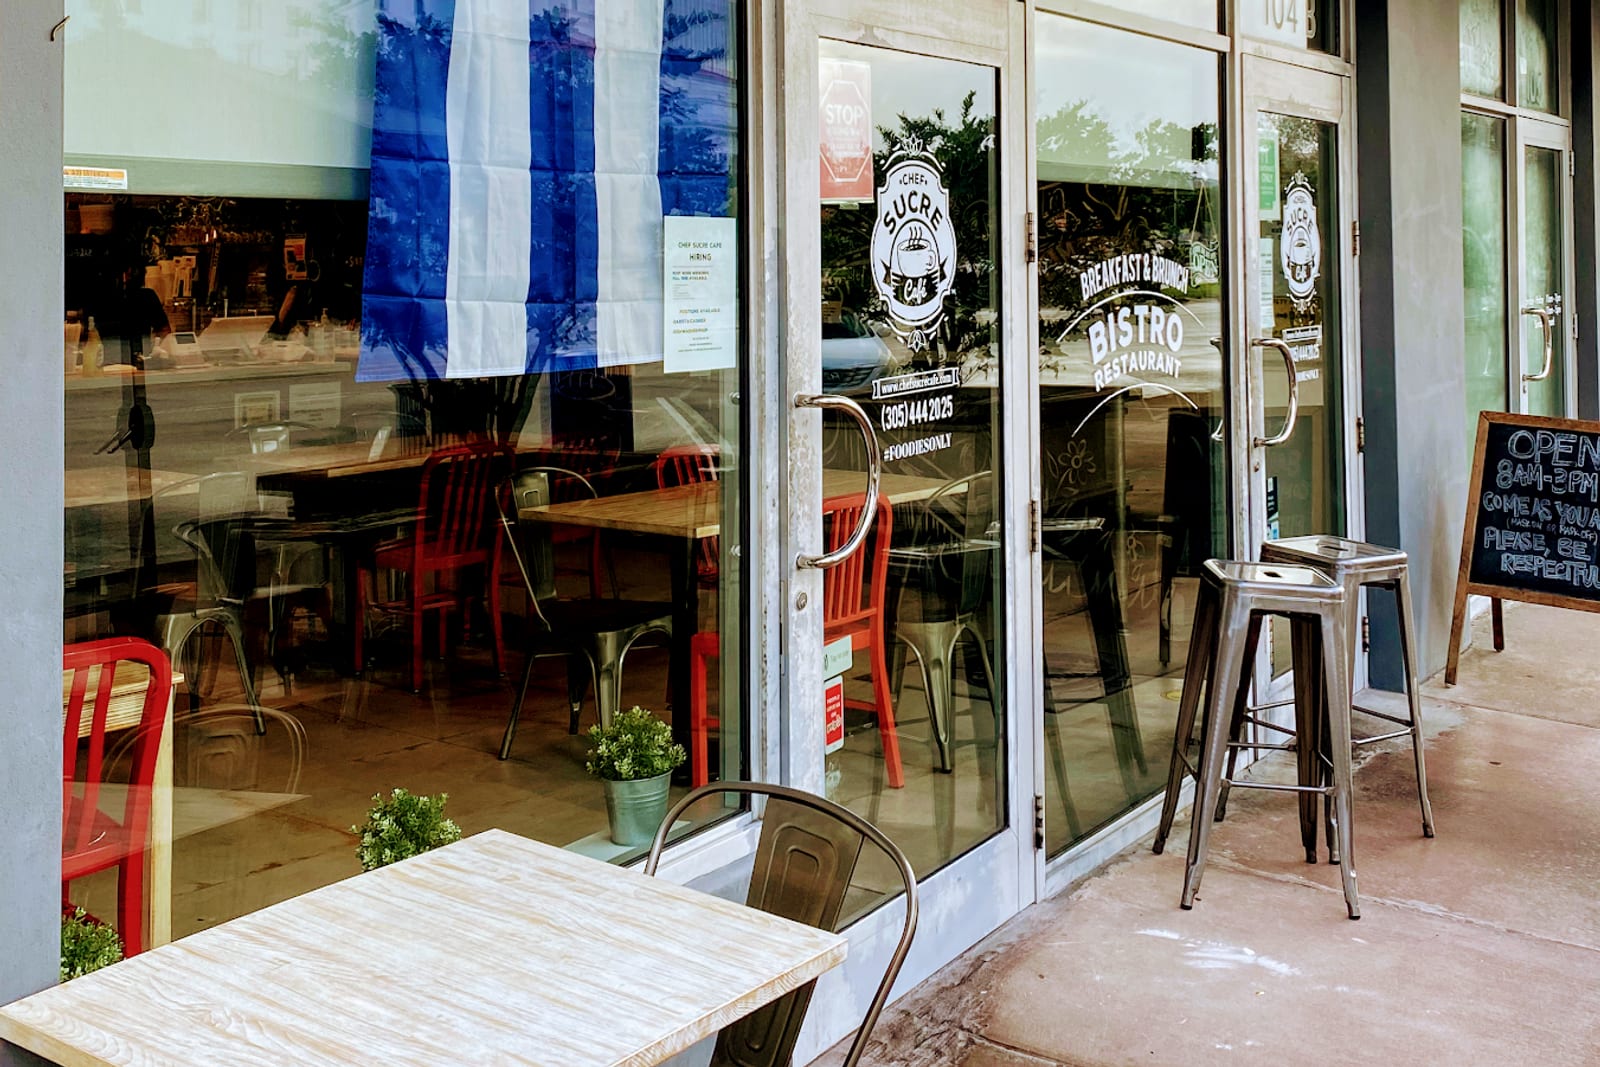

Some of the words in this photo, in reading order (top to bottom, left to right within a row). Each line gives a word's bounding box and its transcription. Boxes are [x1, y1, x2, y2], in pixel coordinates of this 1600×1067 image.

[825, 104, 864, 127] STOP
[902, 173, 925, 186] CHEF
[883, 190, 943, 235] SUCRE
[689, 252, 712, 261] HIRING
[1079, 254, 1140, 301] BREAKFAST
[1143, 253, 1151, 281] &
[1152, 255, 1189, 294] BRUNCH
[1088, 305, 1183, 365] BISTRO
[1094, 351, 1182, 392] RESTAURANT
[883, 432, 952, 462] #FOODIESONLY
[1507, 430, 1600, 471] OPEN
[1496, 458, 1598, 502] 8AM-3PM
[1482, 491, 1530, 518] COME
[1531, 497, 1552, 521] AS
[1554, 500, 1589, 528] YOU
[1557, 537, 1591, 561] BE
